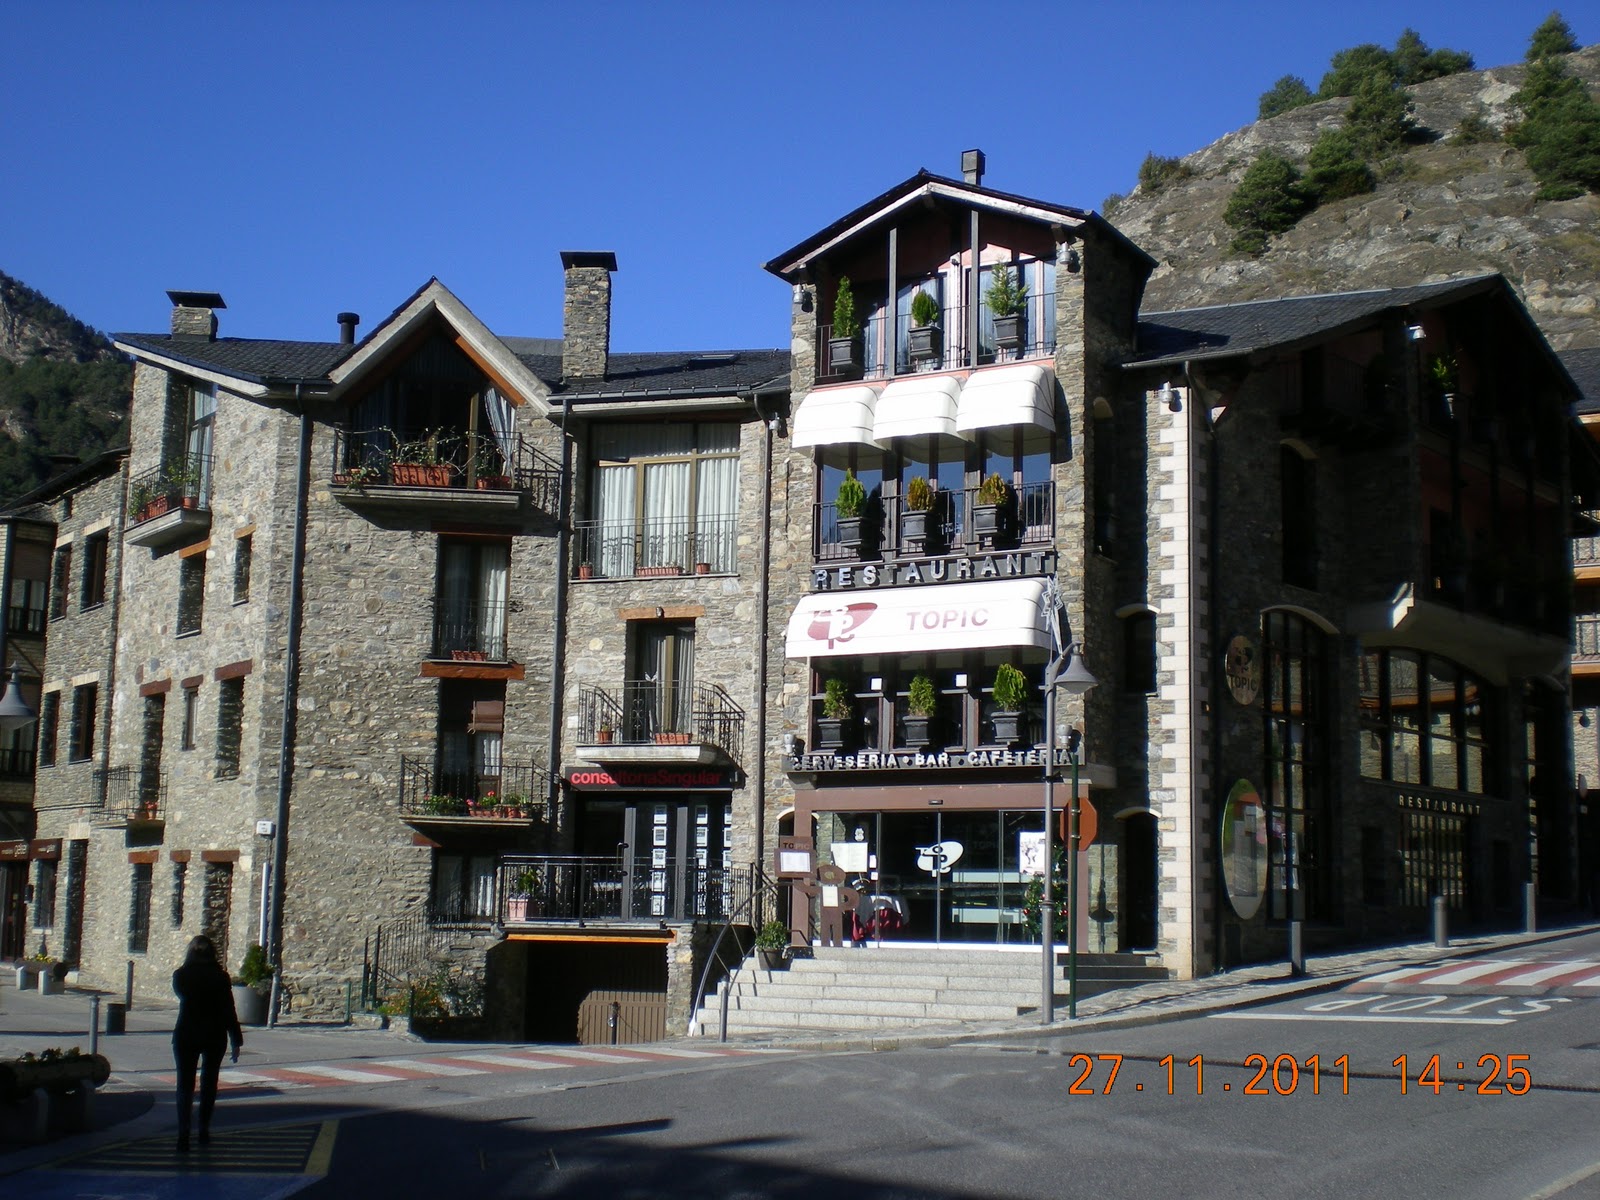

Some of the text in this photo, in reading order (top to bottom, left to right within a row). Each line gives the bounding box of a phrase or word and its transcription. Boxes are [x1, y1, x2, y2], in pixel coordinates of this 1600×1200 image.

[815, 552, 1046, 588] RESTAURANT
[907, 608, 989, 631] TOPIC
[1228, 675, 1258, 691] TOPIC
[791, 749, 1073, 769] CERVESERIA BAR CAFETERIA
[1399, 795, 1481, 815] RESTAURANT
[1304, 994, 1573, 1016] STOP
